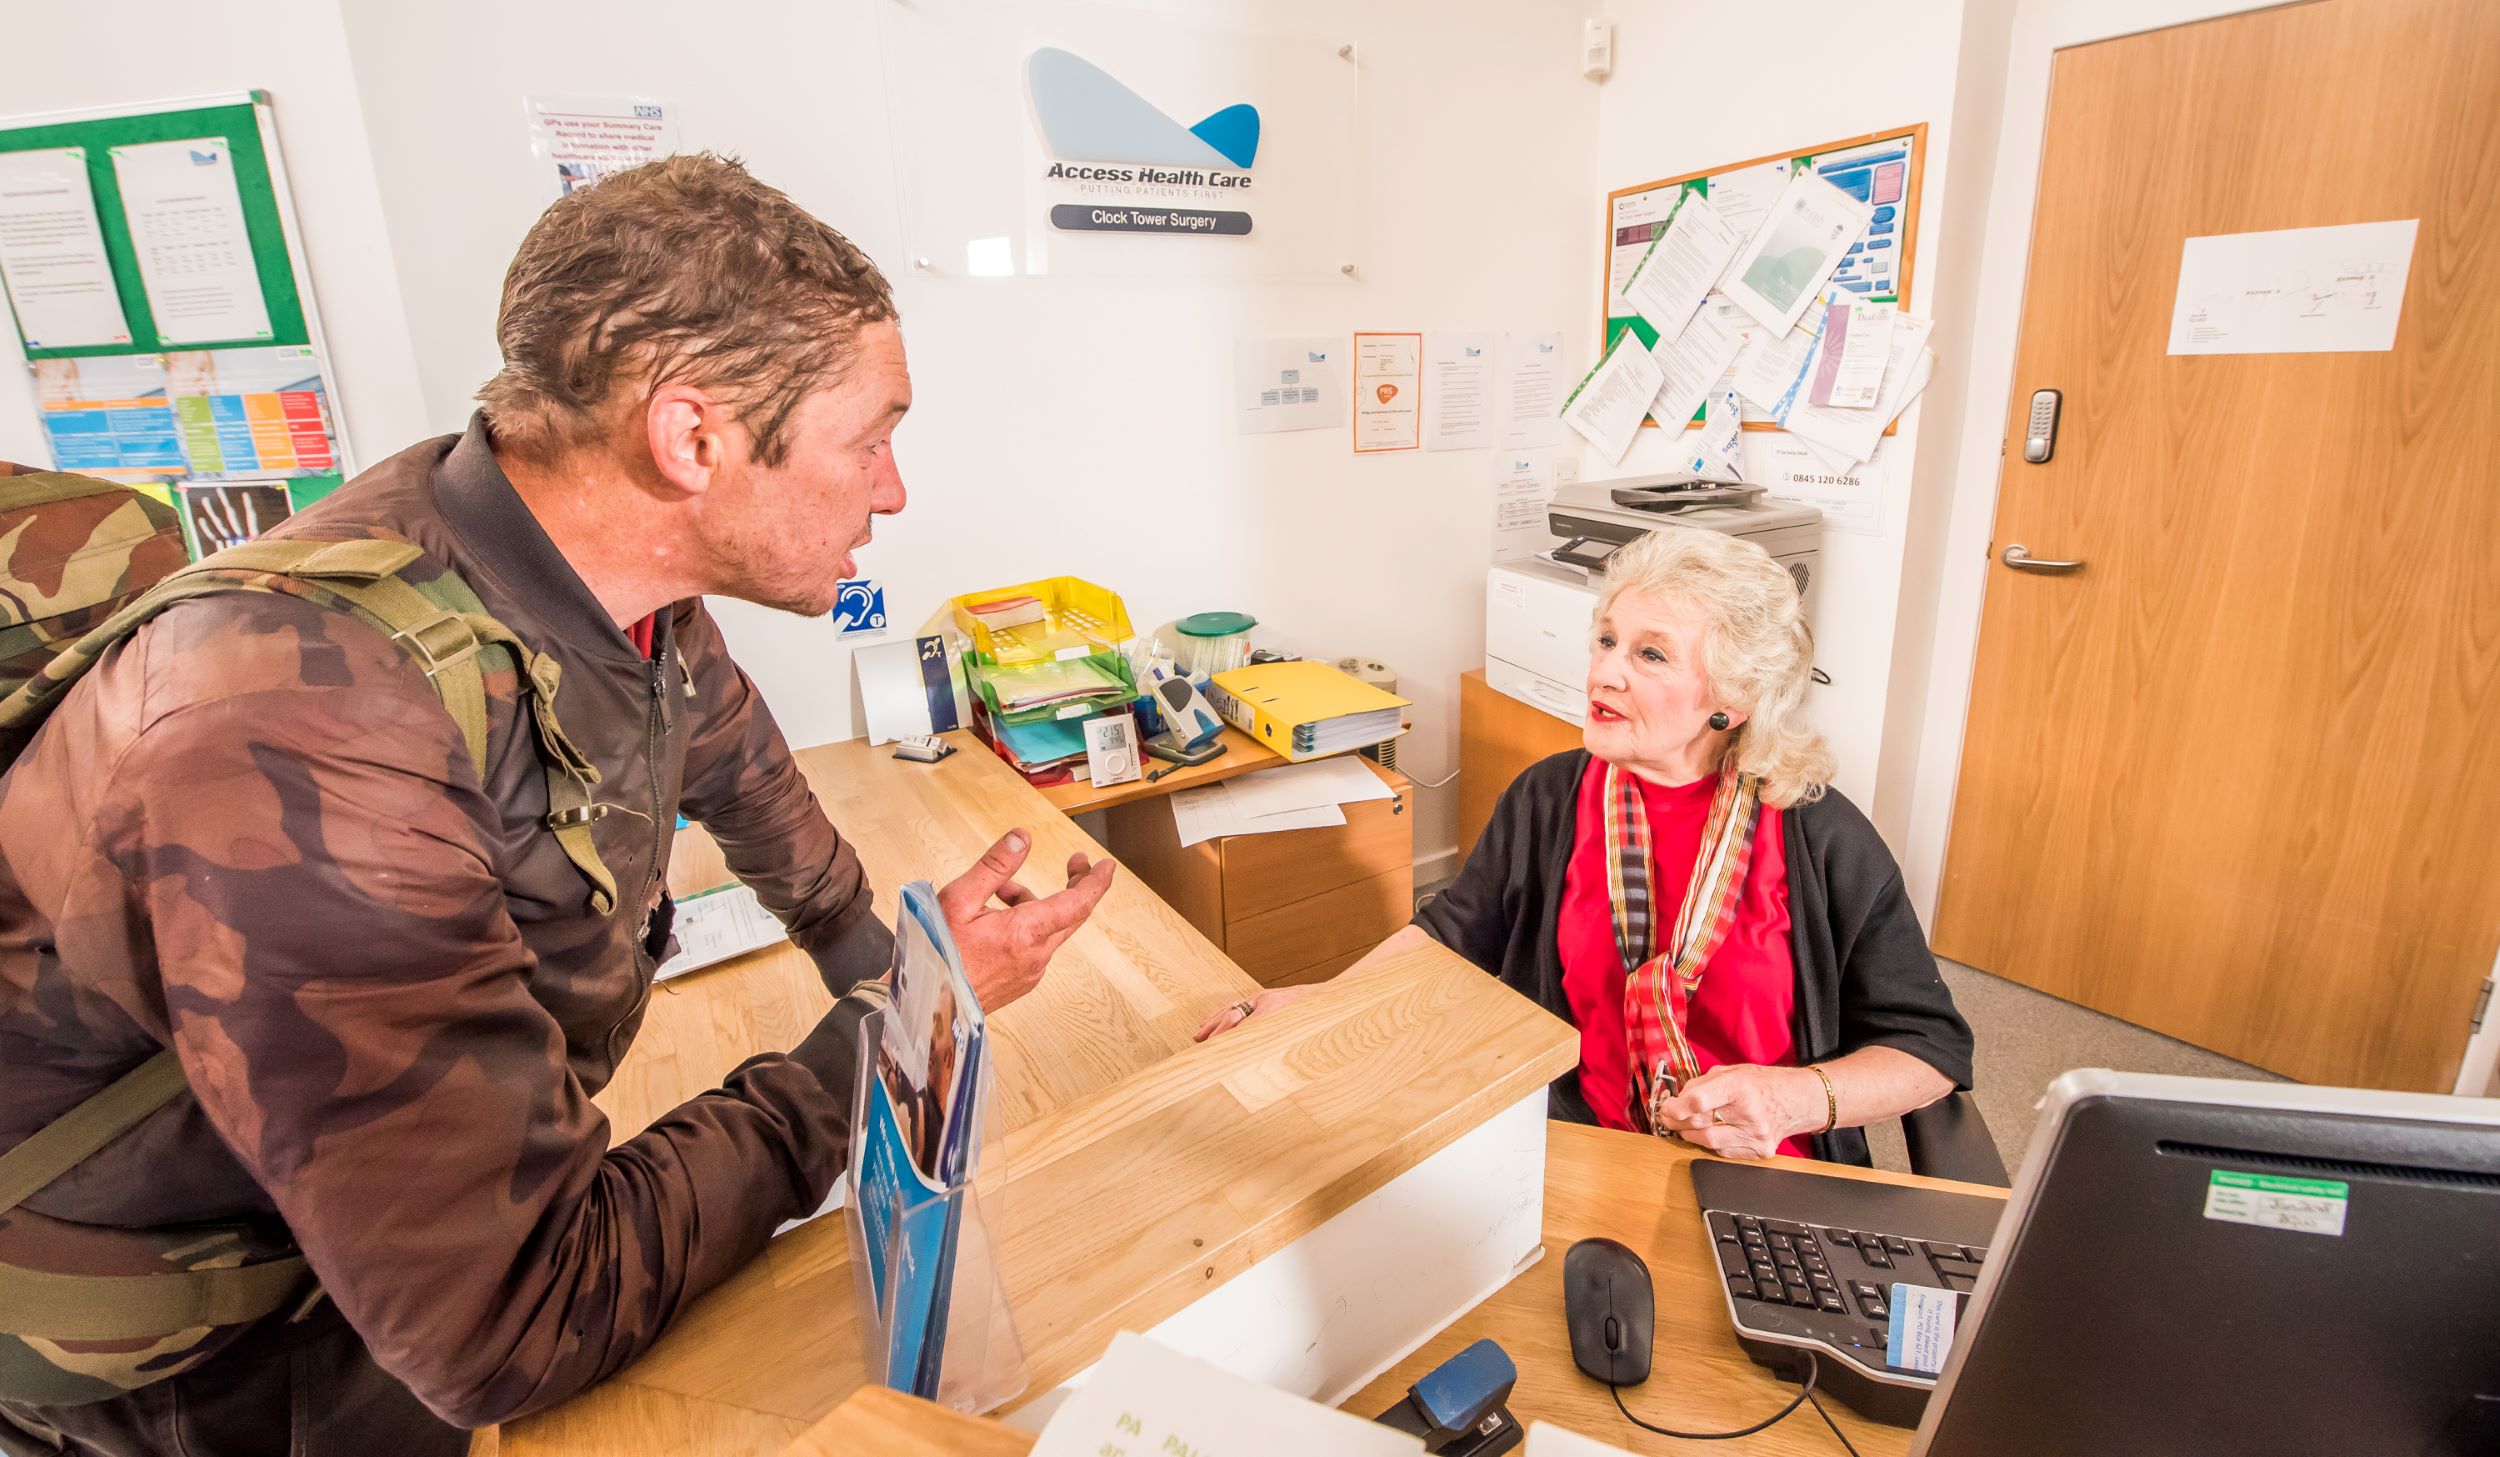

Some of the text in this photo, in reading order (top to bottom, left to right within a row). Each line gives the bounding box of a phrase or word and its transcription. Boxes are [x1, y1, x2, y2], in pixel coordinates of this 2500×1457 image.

[636, 106, 661, 117] NHS
[544, 119, 561, 127] GPs
[582, 122, 600, 130] your
[603, 122, 641, 131] Summary
[643, 123, 662, 131] Care
[599, 132, 622, 140] share
[624, 133, 655, 141] medical
[1047, 162, 1252, 189] Access Health Care
[1080, 184, 1224, 199] PUTTING PATIENTS FIRST
[1091, 209, 1217, 230] Clock Tower Surgery
[1793, 473, 1860, 487] 0845 120 6286
[873, 616, 881, 625] T
[1115, 1412, 1141, 1438] PA
